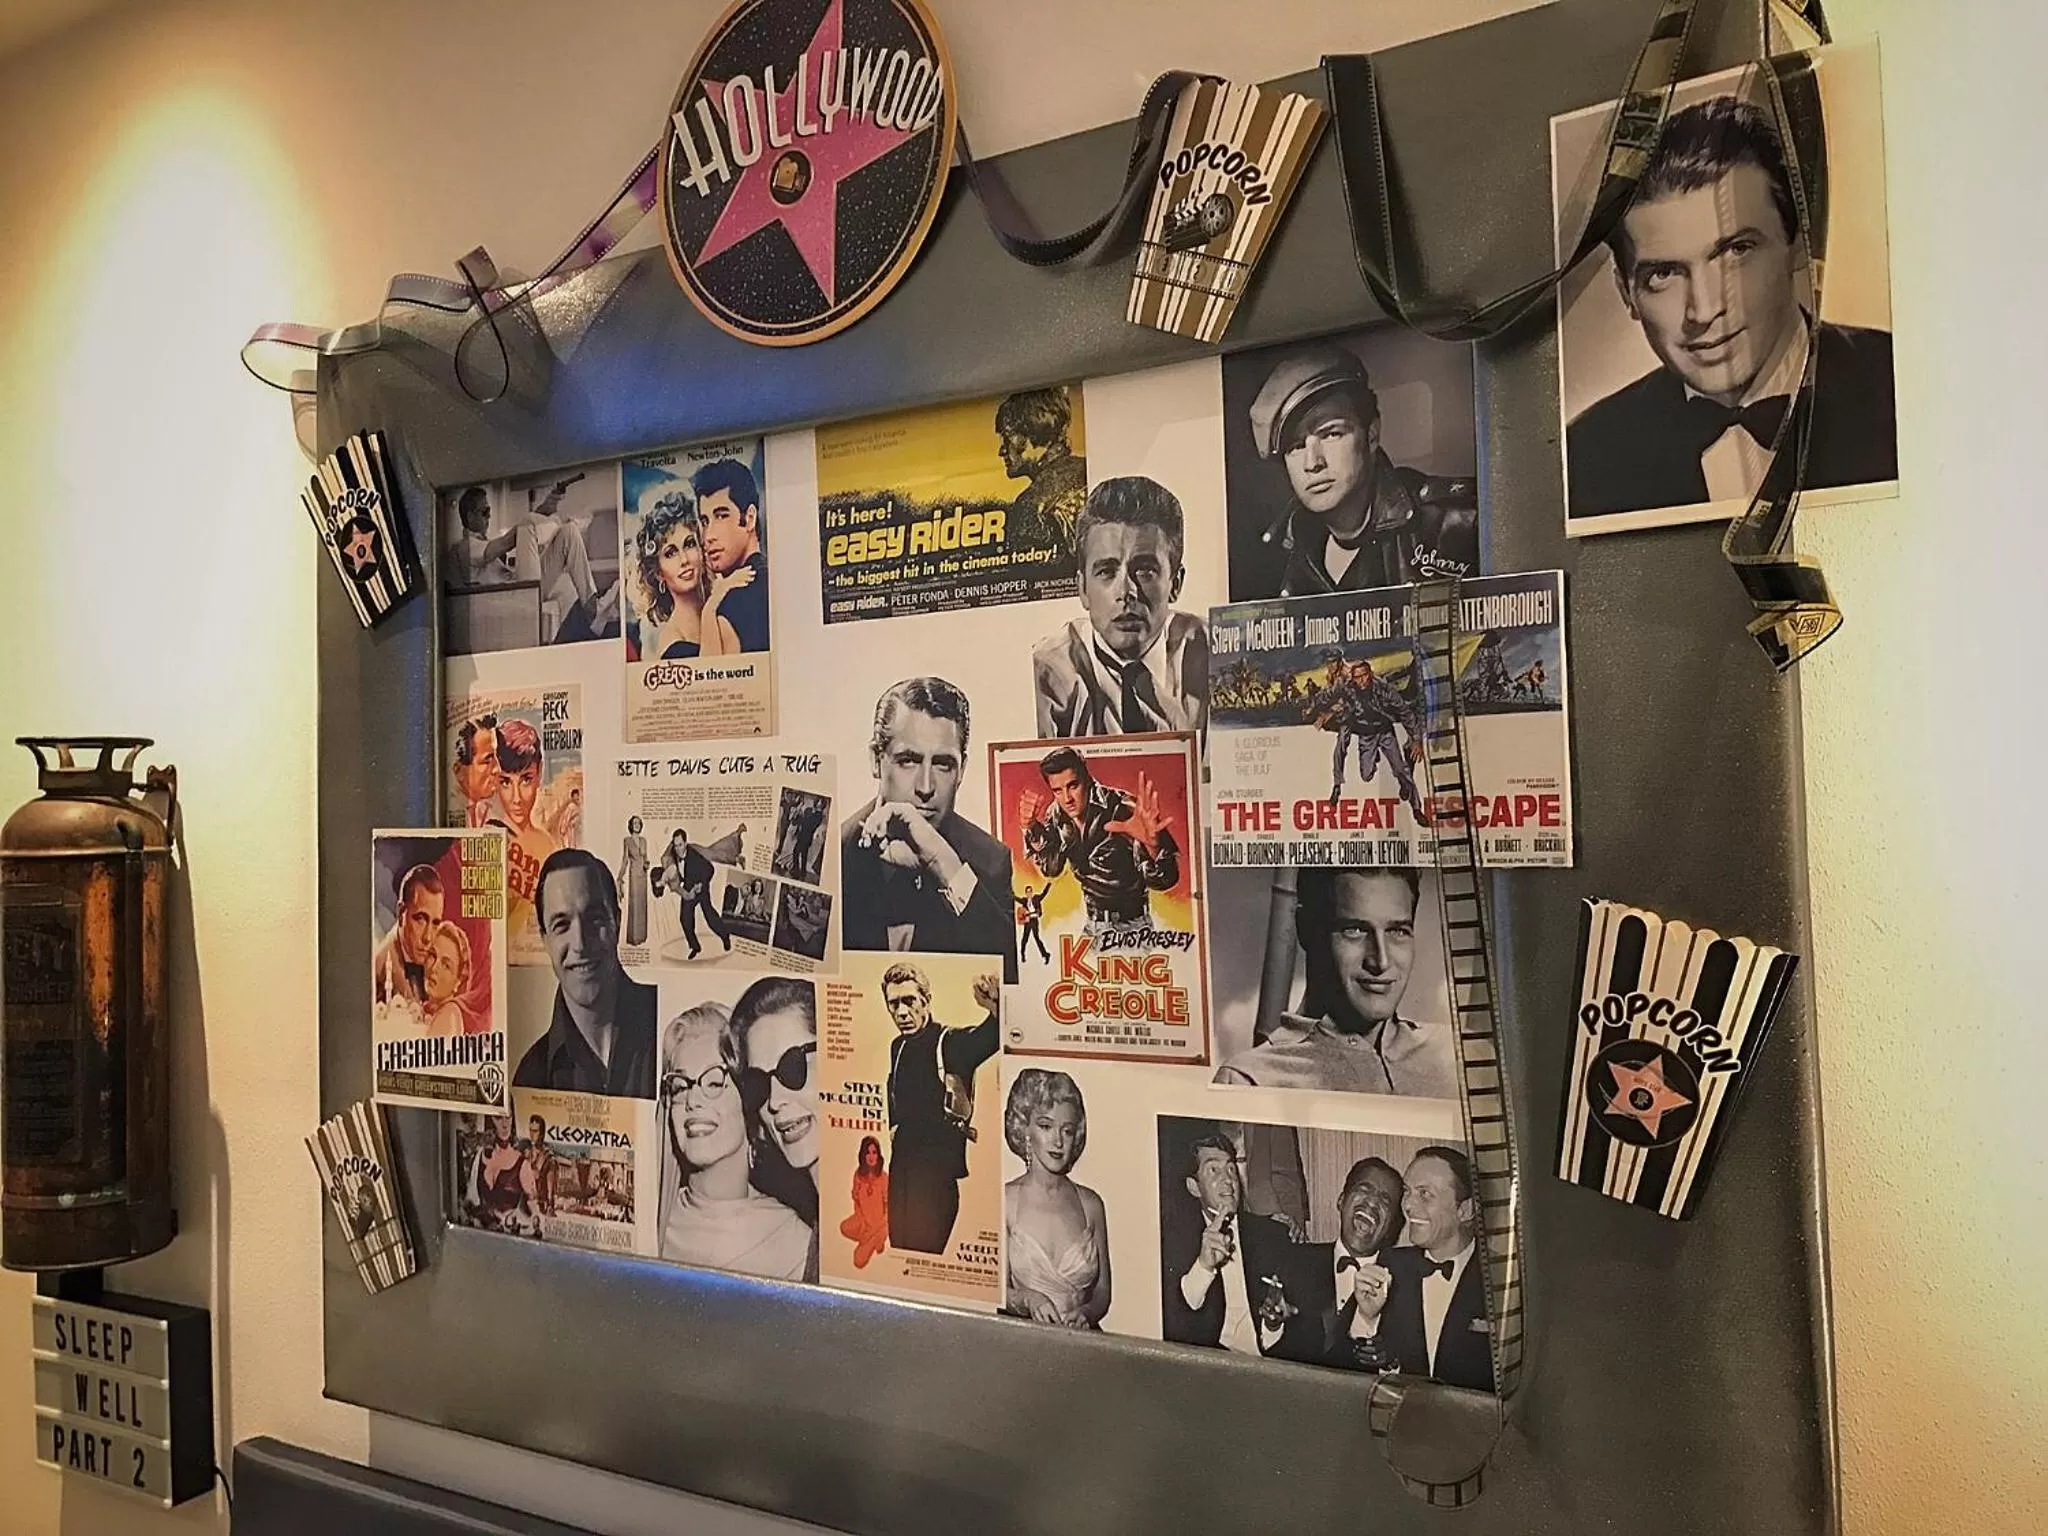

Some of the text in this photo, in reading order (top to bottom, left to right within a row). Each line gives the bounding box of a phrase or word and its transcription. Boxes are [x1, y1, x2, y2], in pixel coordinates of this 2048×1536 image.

[672, 48, 943, 198] HOLLYWOOD
[1160, 144, 1271, 206] POPCORN
[325, 488, 381, 547] POPCORN
[826, 501, 891, 528] It's here!
[827, 525, 904, 566] easy
[857, 569, 900, 586] biggest
[904, 563, 920, 578] hit
[923, 559, 935, 575] in
[940, 557, 959, 573] the
[963, 552, 1008, 570] cinema
[1011, 544, 1057, 565] today!
[891, 593, 918, 606] PETER
[920, 589, 949, 602] FONDA
[954, 584, 988, 598] DENNIS
[990, 579, 1028, 593] HOPPER
[1212, 625, 1240, 655] Steve
[1246, 616, 1295, 651] McQUEEN
[1304, 614, 1339, 648] James
[1346, 607, 1391, 642] GARNER
[644, 661, 693, 691] GREASE
[694, 665, 754, 681] is the word
[543, 700, 569, 721] PECK
[617, 754, 821, 777] BETTE DAVIS CUTS A RUG
[1217, 801, 1281, 832] THE
[1293, 797, 1400, 832] GREAT
[461, 837, 502, 861] BOGART
[1213, 842, 1243, 865] DONALD
[1247, 842, 1285, 865] BRONSON
[1289, 841, 1334, 865] PLEASENCE
[1338, 840, 1373, 864] COBURN
[1378, 840, 1410, 864] LEYTON
[461, 865, 502, 890] BERGMAN
[461, 894, 502, 919] HENREID
[1100, 927, 1195, 952] ELVIS PRESLEY
[1059, 934, 1173, 987] KING
[1044, 981, 1190, 1027] CREOLE
[377, 1031, 505, 1071] CASABLANCA
[1579, 992, 1741, 1073] POPCORN
[547, 1124, 631, 1148] CLEOPATRA
[330, 1155, 382, 1204] POPCORN
[55, 1313, 132, 1364] SLEEP
[75, 1373, 142, 1428] WELL
[53, 1424, 145, 1488] PART 2
